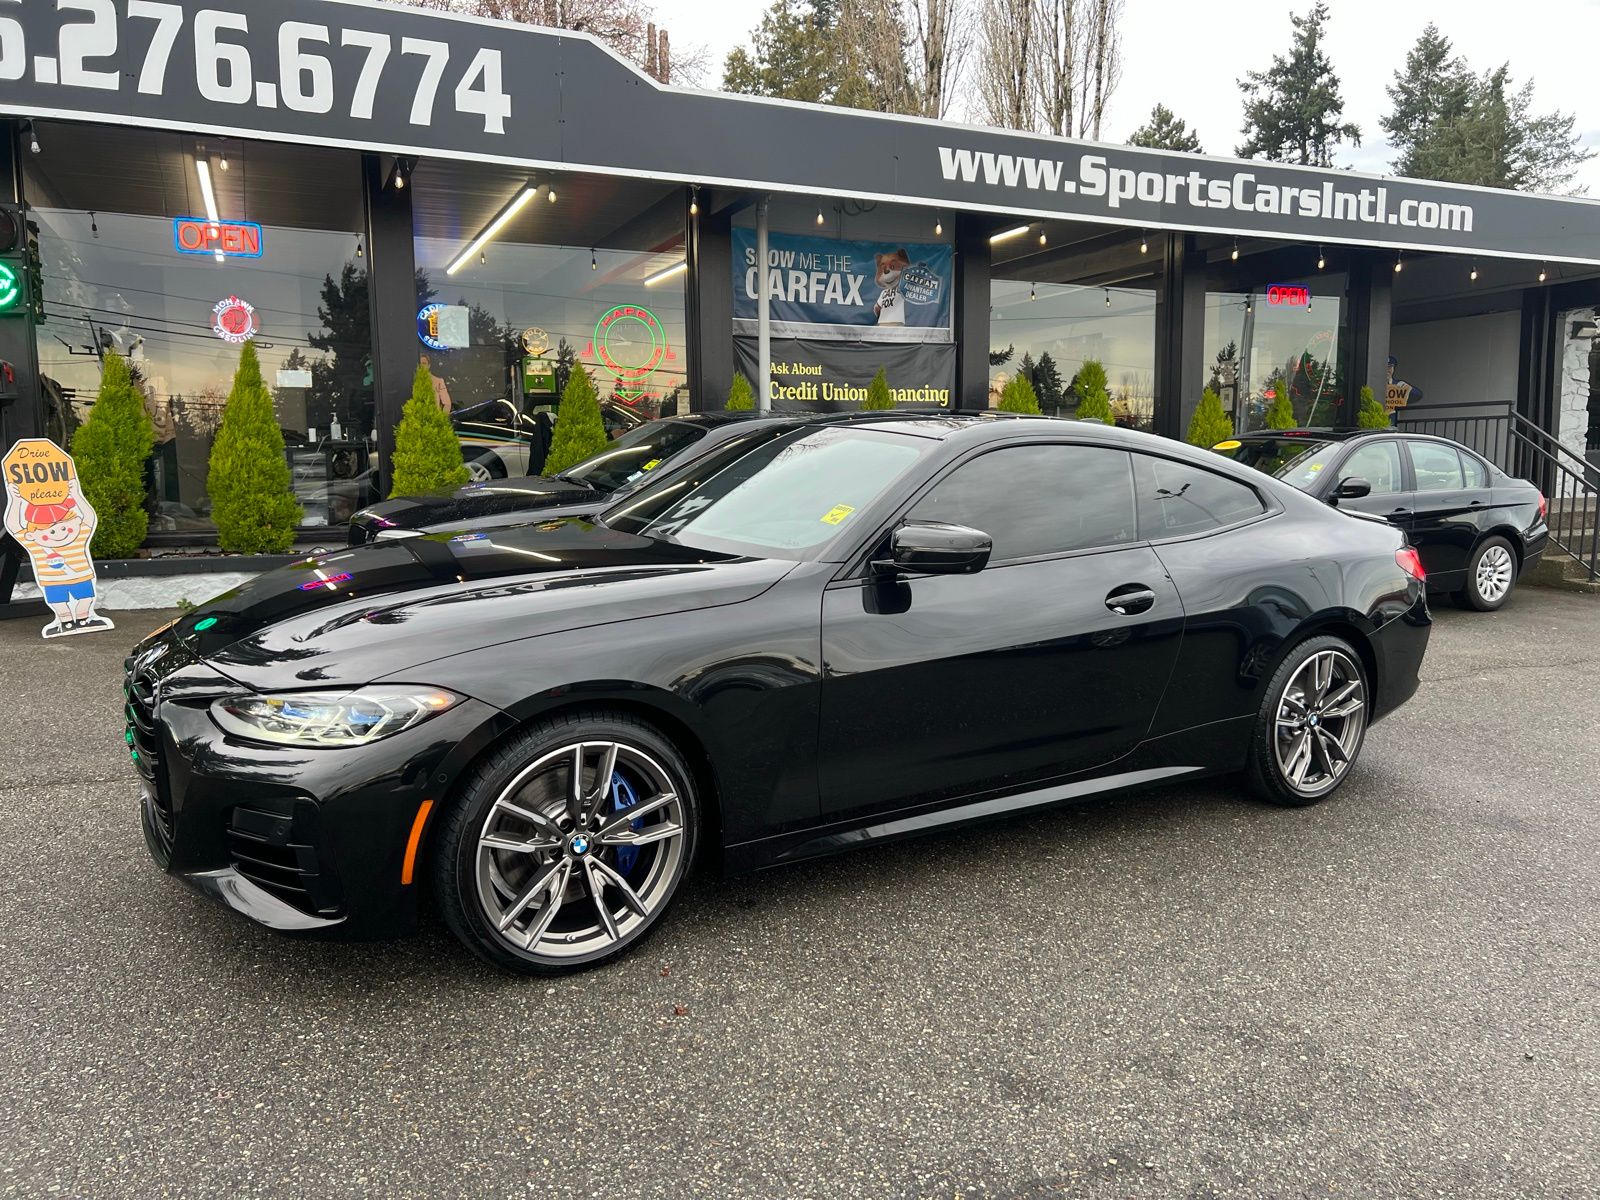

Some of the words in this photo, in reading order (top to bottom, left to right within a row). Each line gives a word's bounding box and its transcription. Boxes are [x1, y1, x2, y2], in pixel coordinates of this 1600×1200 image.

[938, 146, 1473, 232] www.SportsCarsIntl.com
[180, 222, 259, 253] OPEN
[745, 247, 796, 269] SOW
[800, 252, 821, 271] ME
[824, 254, 852, 273] THE
[745, 266, 865, 306] CARFAX
[905, 290, 927, 302] DEALER
[1268, 286, 1307, 306] OPEN
[212, 298, 255, 313] MOHAWK
[881, 298, 895, 309] FOX
[601, 307, 656, 328] HAPPY
[213, 325, 258, 343] GASOLINE
[770, 362, 790, 375] Ask
[791, 363, 823, 376] About
[769, 381, 818, 401] Credit
[822, 383, 868, 402] Union
[888, 384, 949, 407] nancing
[17, 447, 50, 459] Drive
[9, 461, 69, 484] SLOW
[30, 488, 63, 501] please
